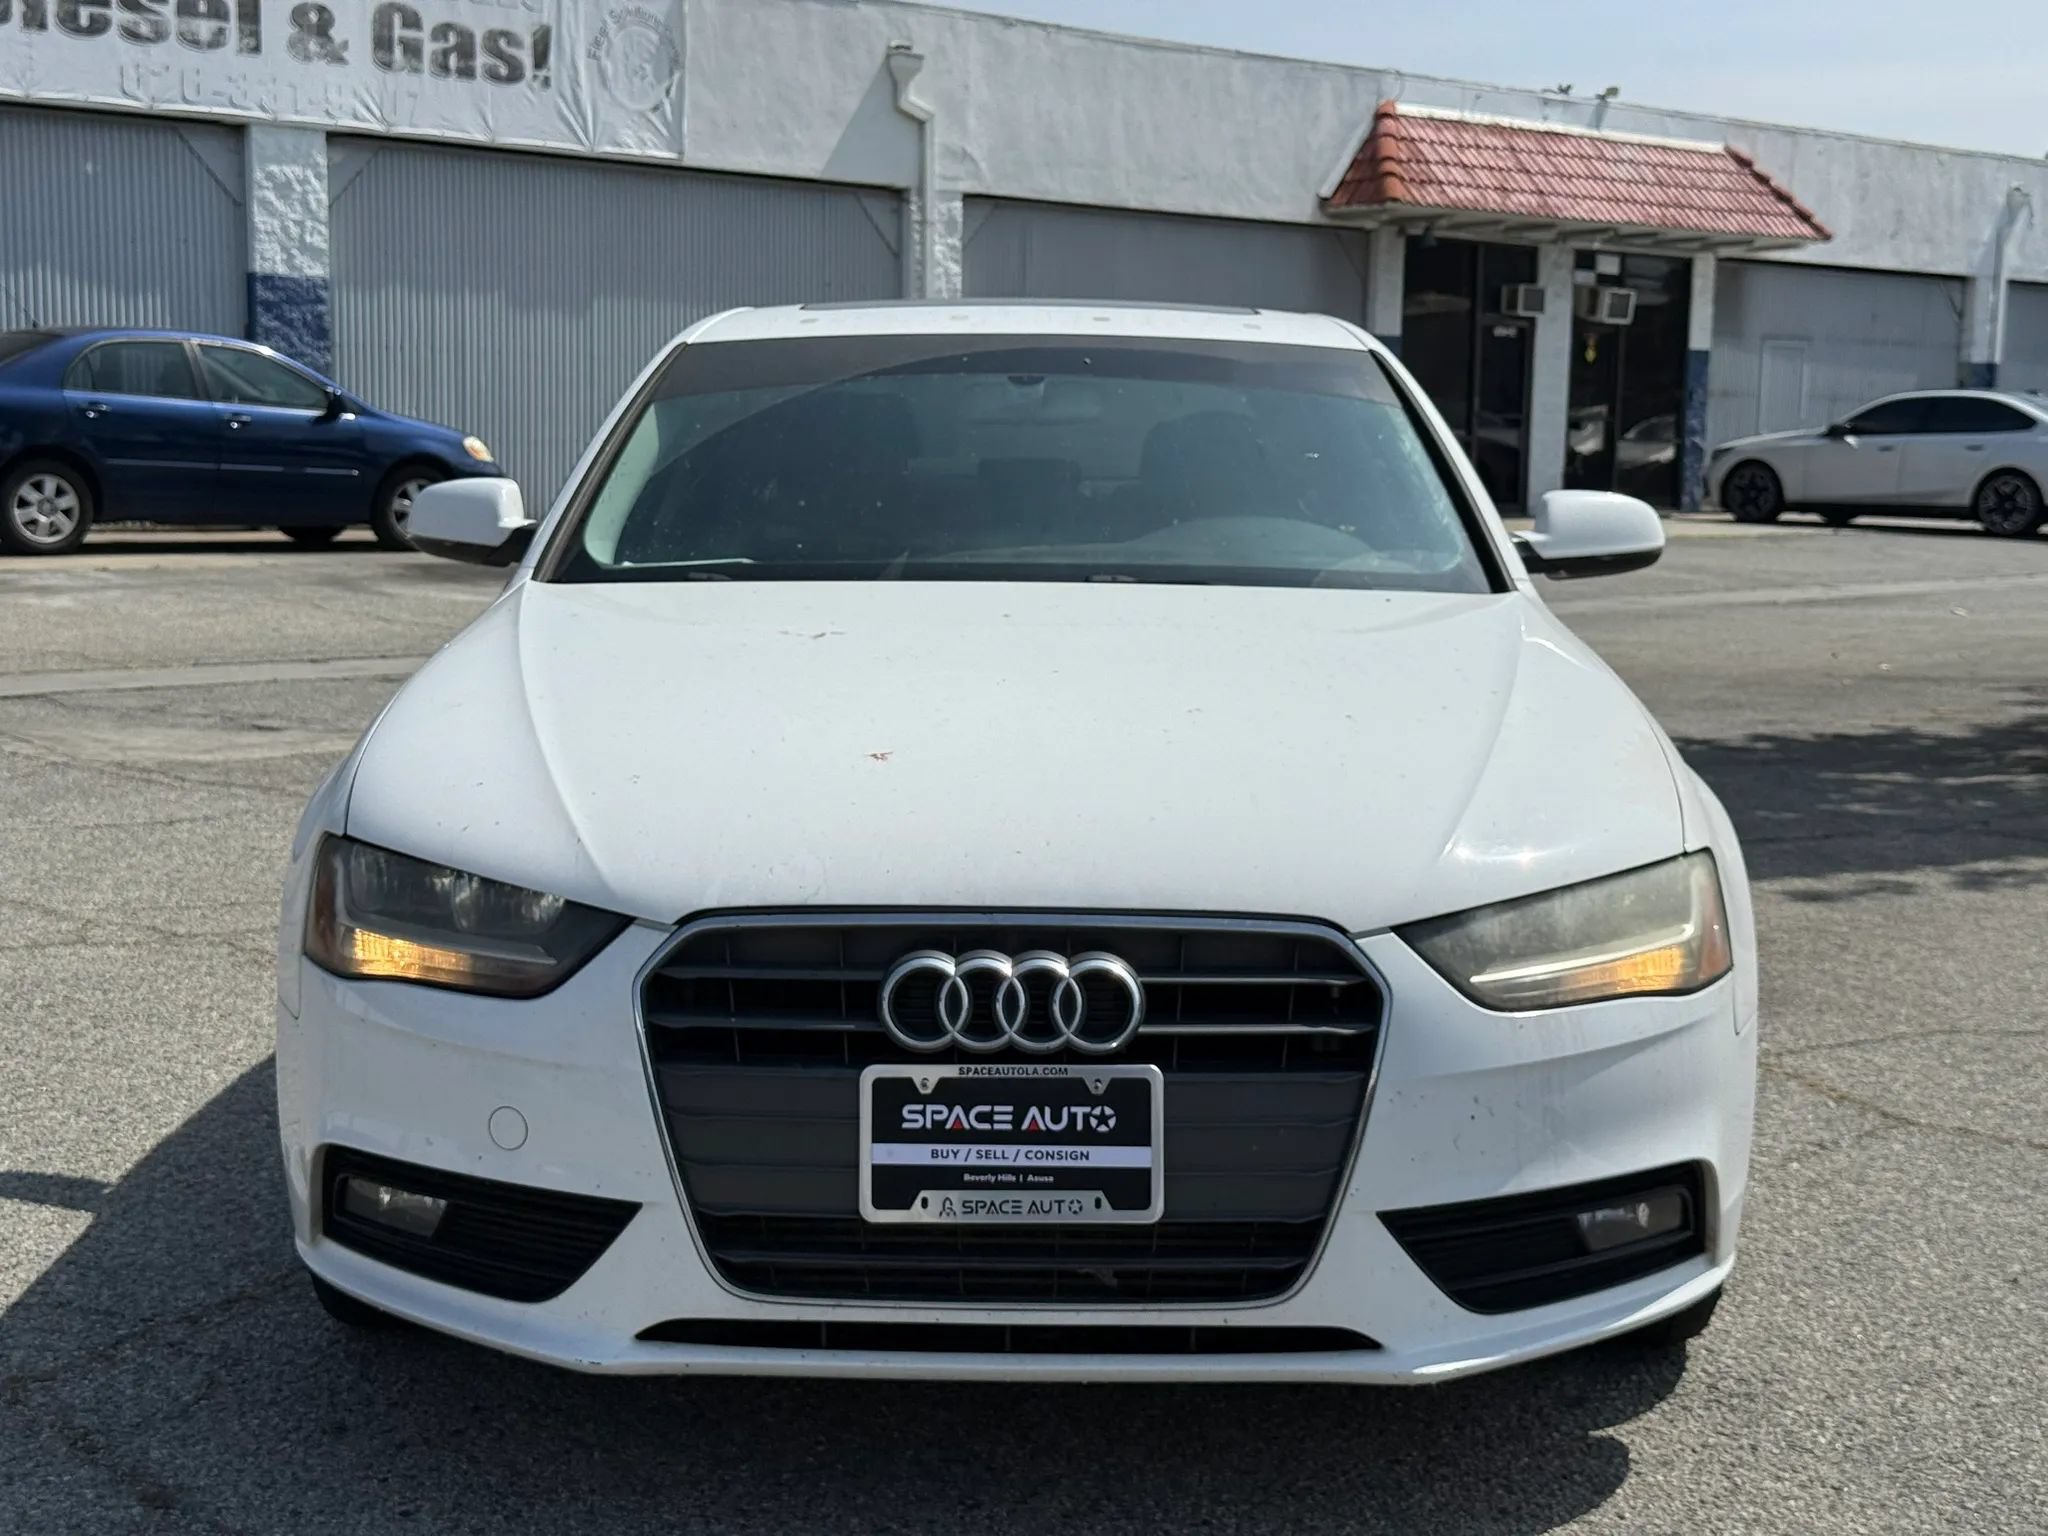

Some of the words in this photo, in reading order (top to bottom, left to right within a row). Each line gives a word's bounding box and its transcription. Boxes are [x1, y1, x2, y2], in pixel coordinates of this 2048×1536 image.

[287, 2, 349, 65] &
[371, 1, 552, 89] Gas!
[958, 1066, 1069, 1076] SPACEAUTOLA.COM
[901, 1104, 1014, 1130] SPACE
[1021, 1105, 1117, 1132] AUTO
[930, 1149, 960, 1160] BUY
[975, 1149, 1009, 1161] SELL
[1025, 1150, 1090, 1162] CONSIGN
[963, 1173, 997, 1184] Beverly
[997, 1173, 1016, 1182] Hills
[961, 1199, 1023, 1215] SPACE
[1027, 1199, 1083, 1215] AUTO
